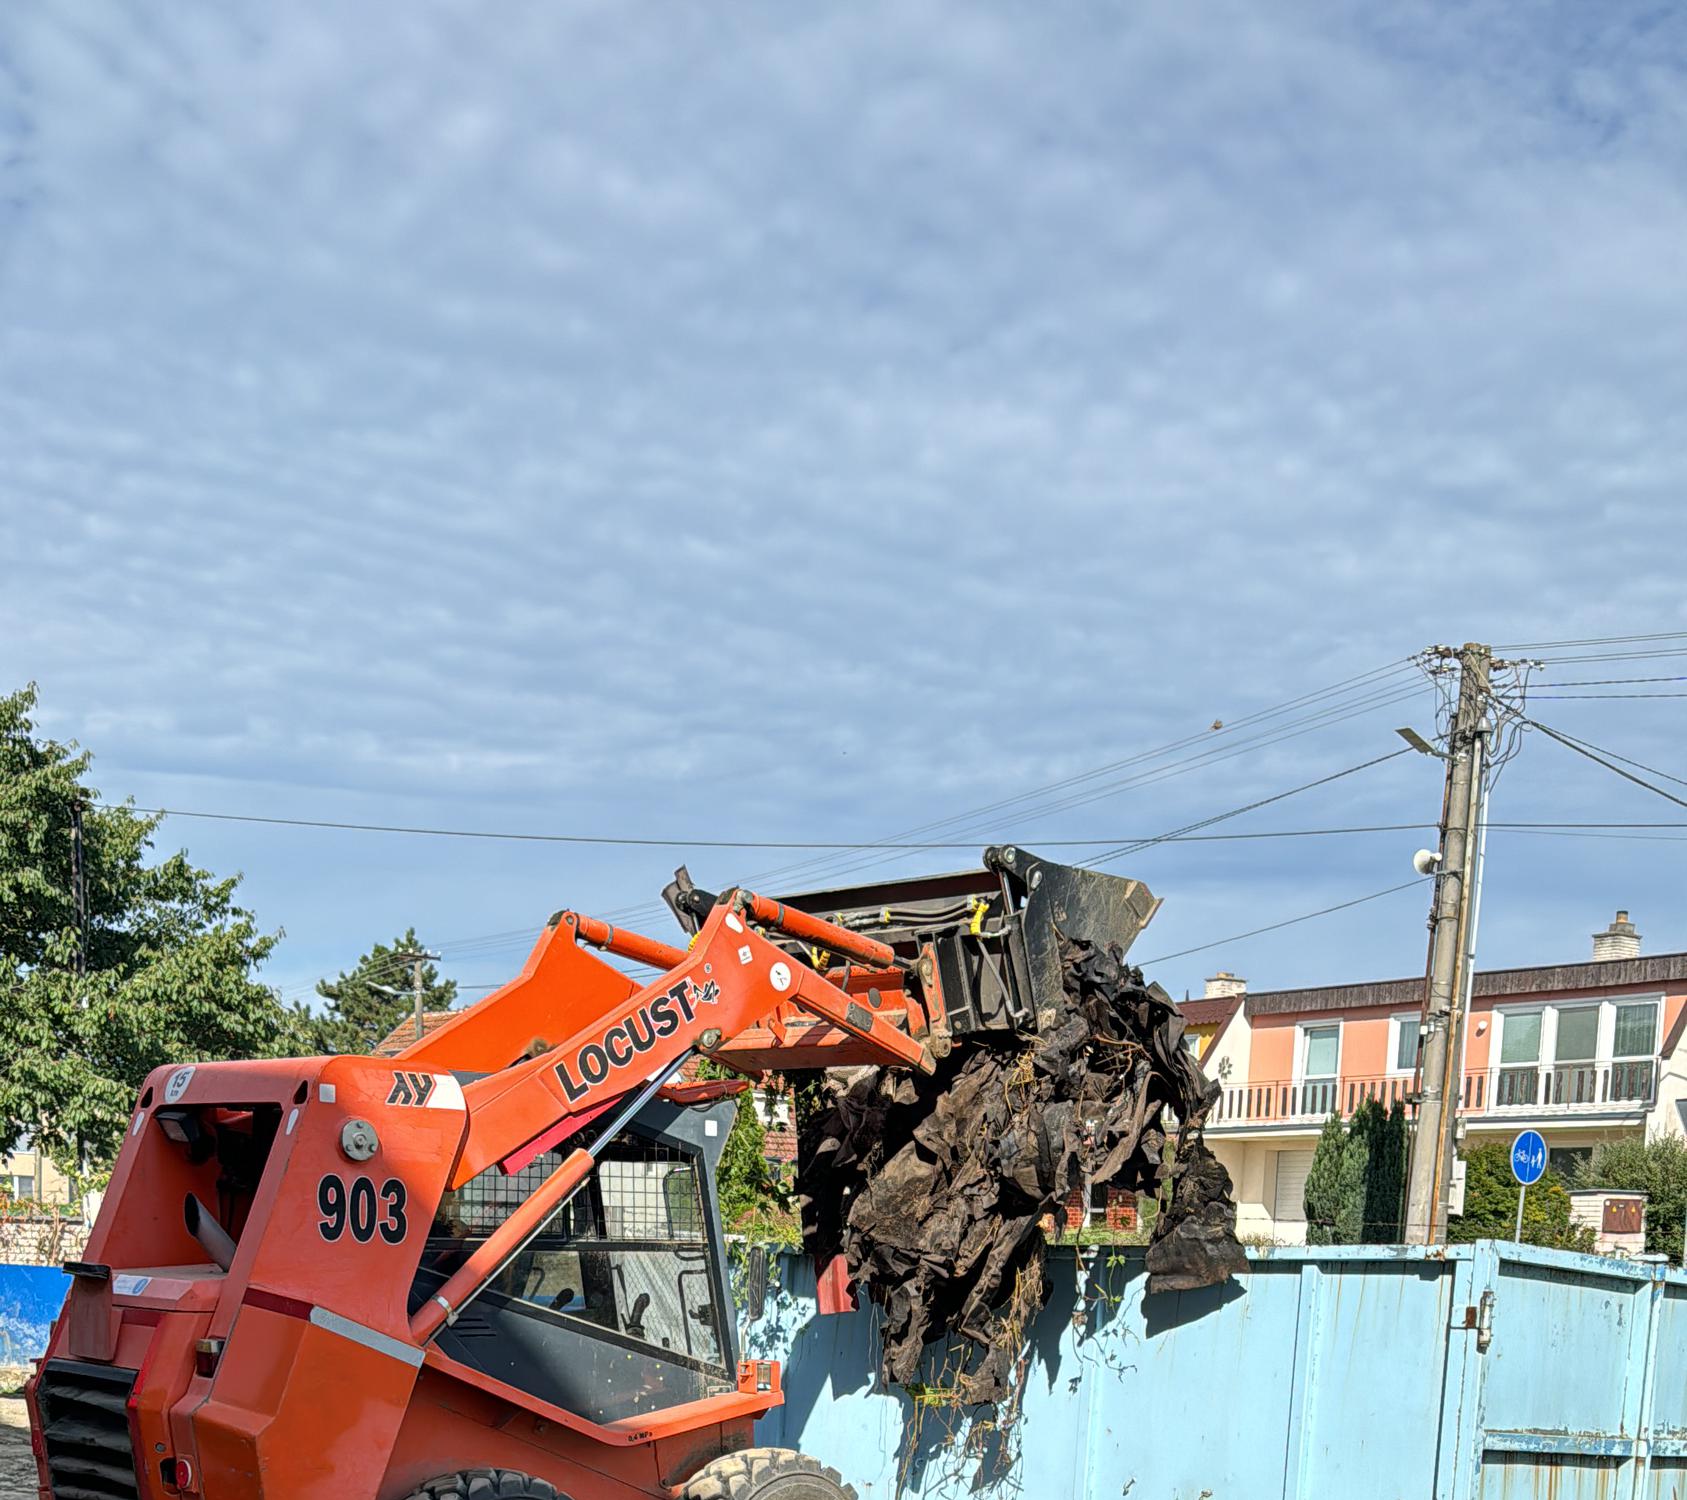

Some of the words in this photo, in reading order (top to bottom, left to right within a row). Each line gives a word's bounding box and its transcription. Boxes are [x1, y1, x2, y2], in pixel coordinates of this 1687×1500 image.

[553, 977, 697, 1104] LOCUST
[172, 1071, 190, 1089] 15
[317, 1173, 408, 1245] 903
